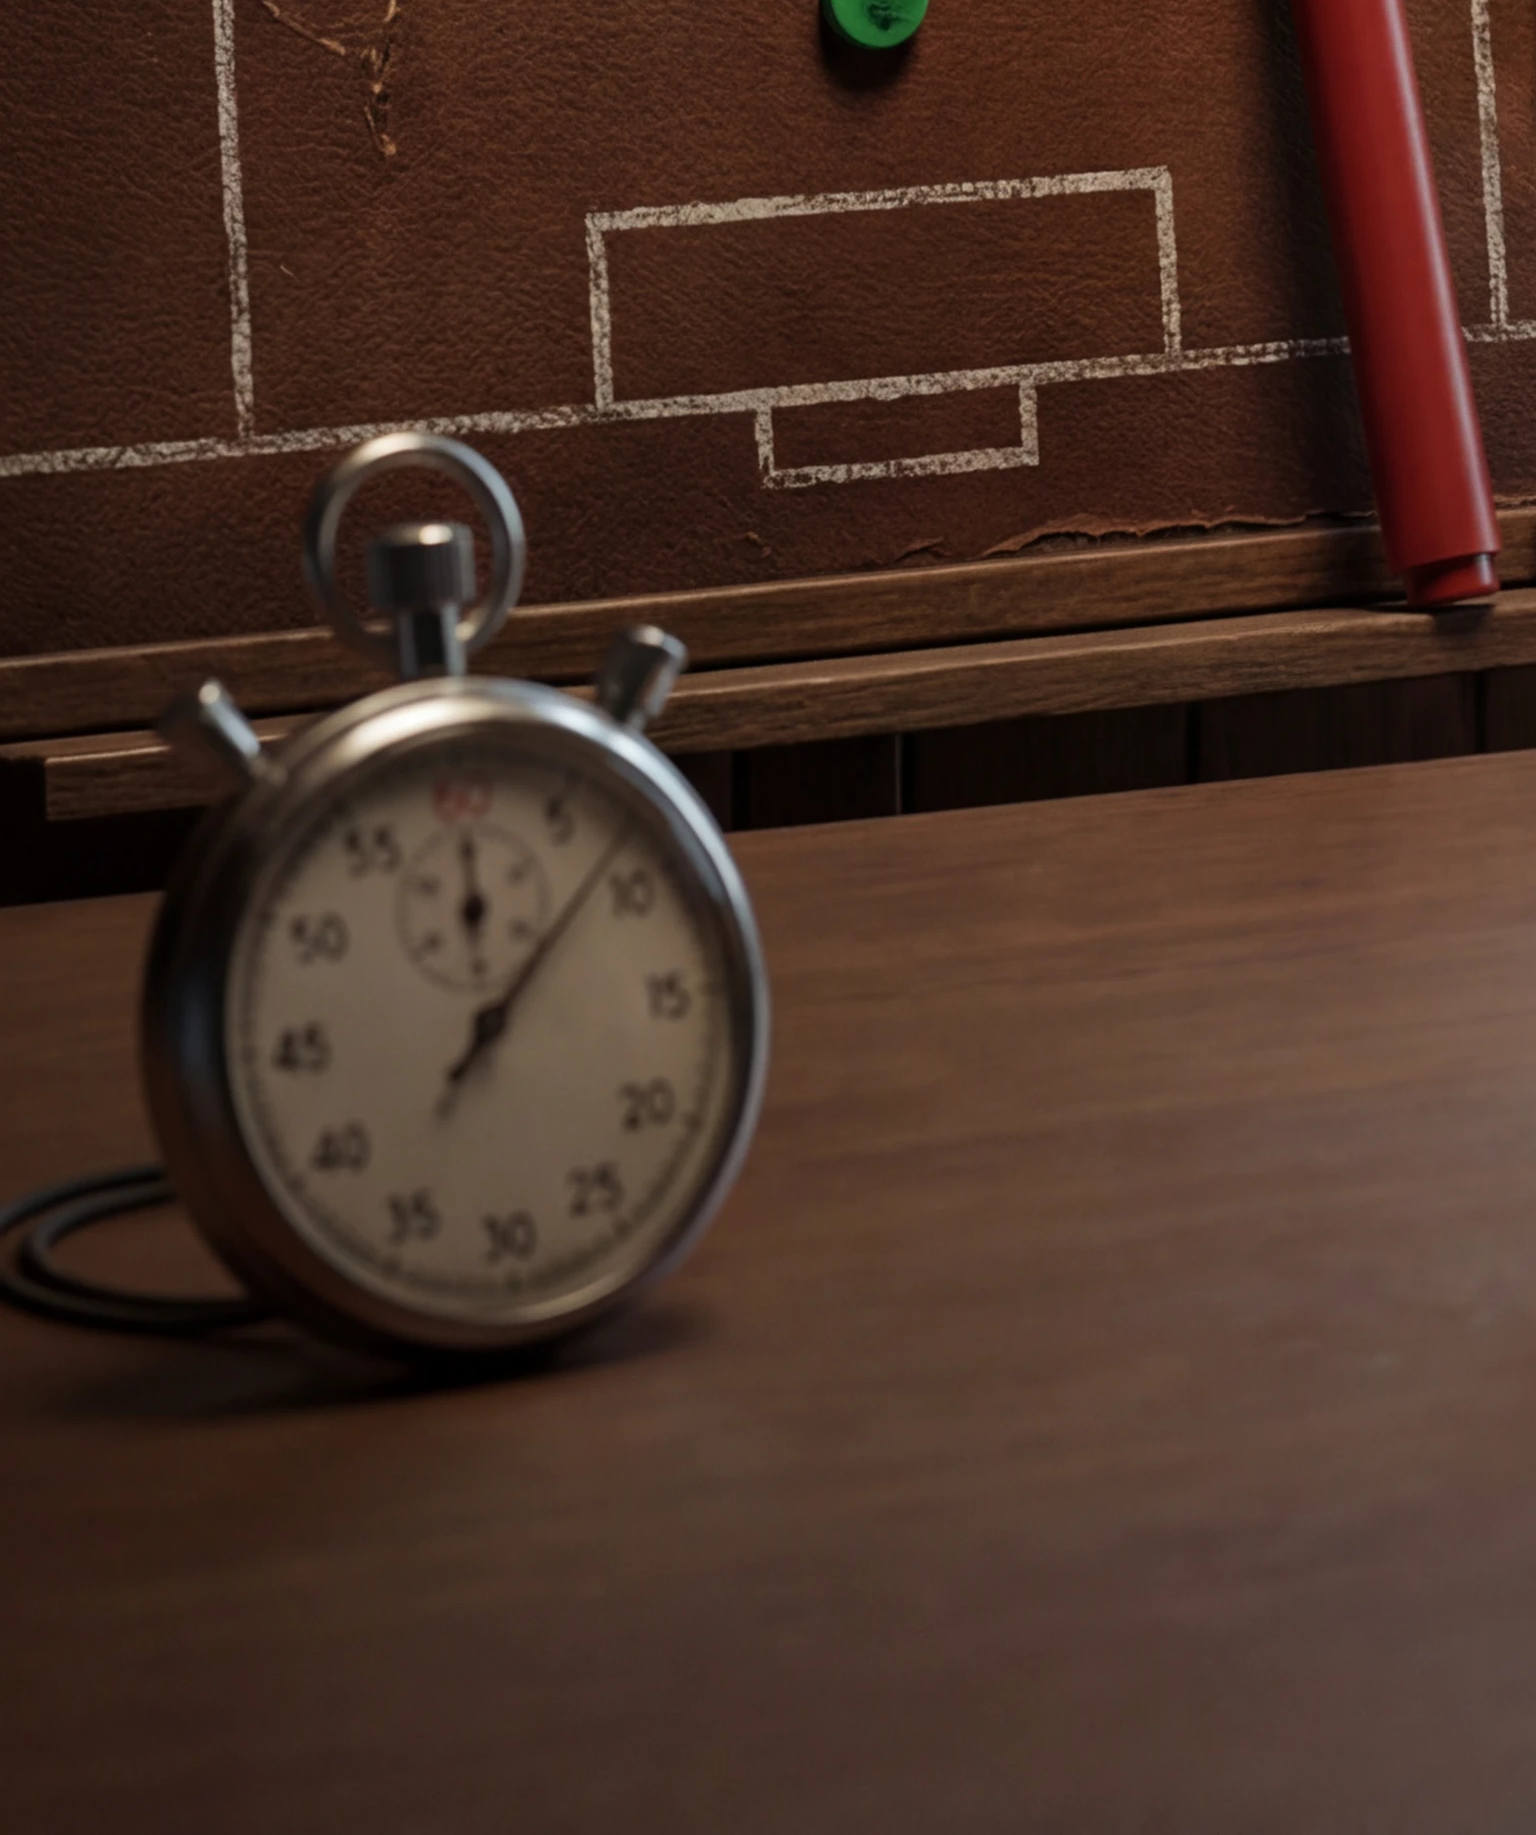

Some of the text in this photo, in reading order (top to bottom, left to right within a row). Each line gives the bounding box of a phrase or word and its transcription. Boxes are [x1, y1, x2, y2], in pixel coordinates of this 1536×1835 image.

[543, 797, 575, 845] 5
[344, 824, 402, 875] 55
[608, 867, 655, 917] 10
[290, 911, 350, 963] 50
[646, 971, 689, 1019] 15
[272, 1021, 331, 1074] 45
[618, 1079, 675, 1133] 20
[312, 1120, 371, 1172] 40
[567, 1162, 625, 1217] 25
[480, 1210, 536, 1263] 30
